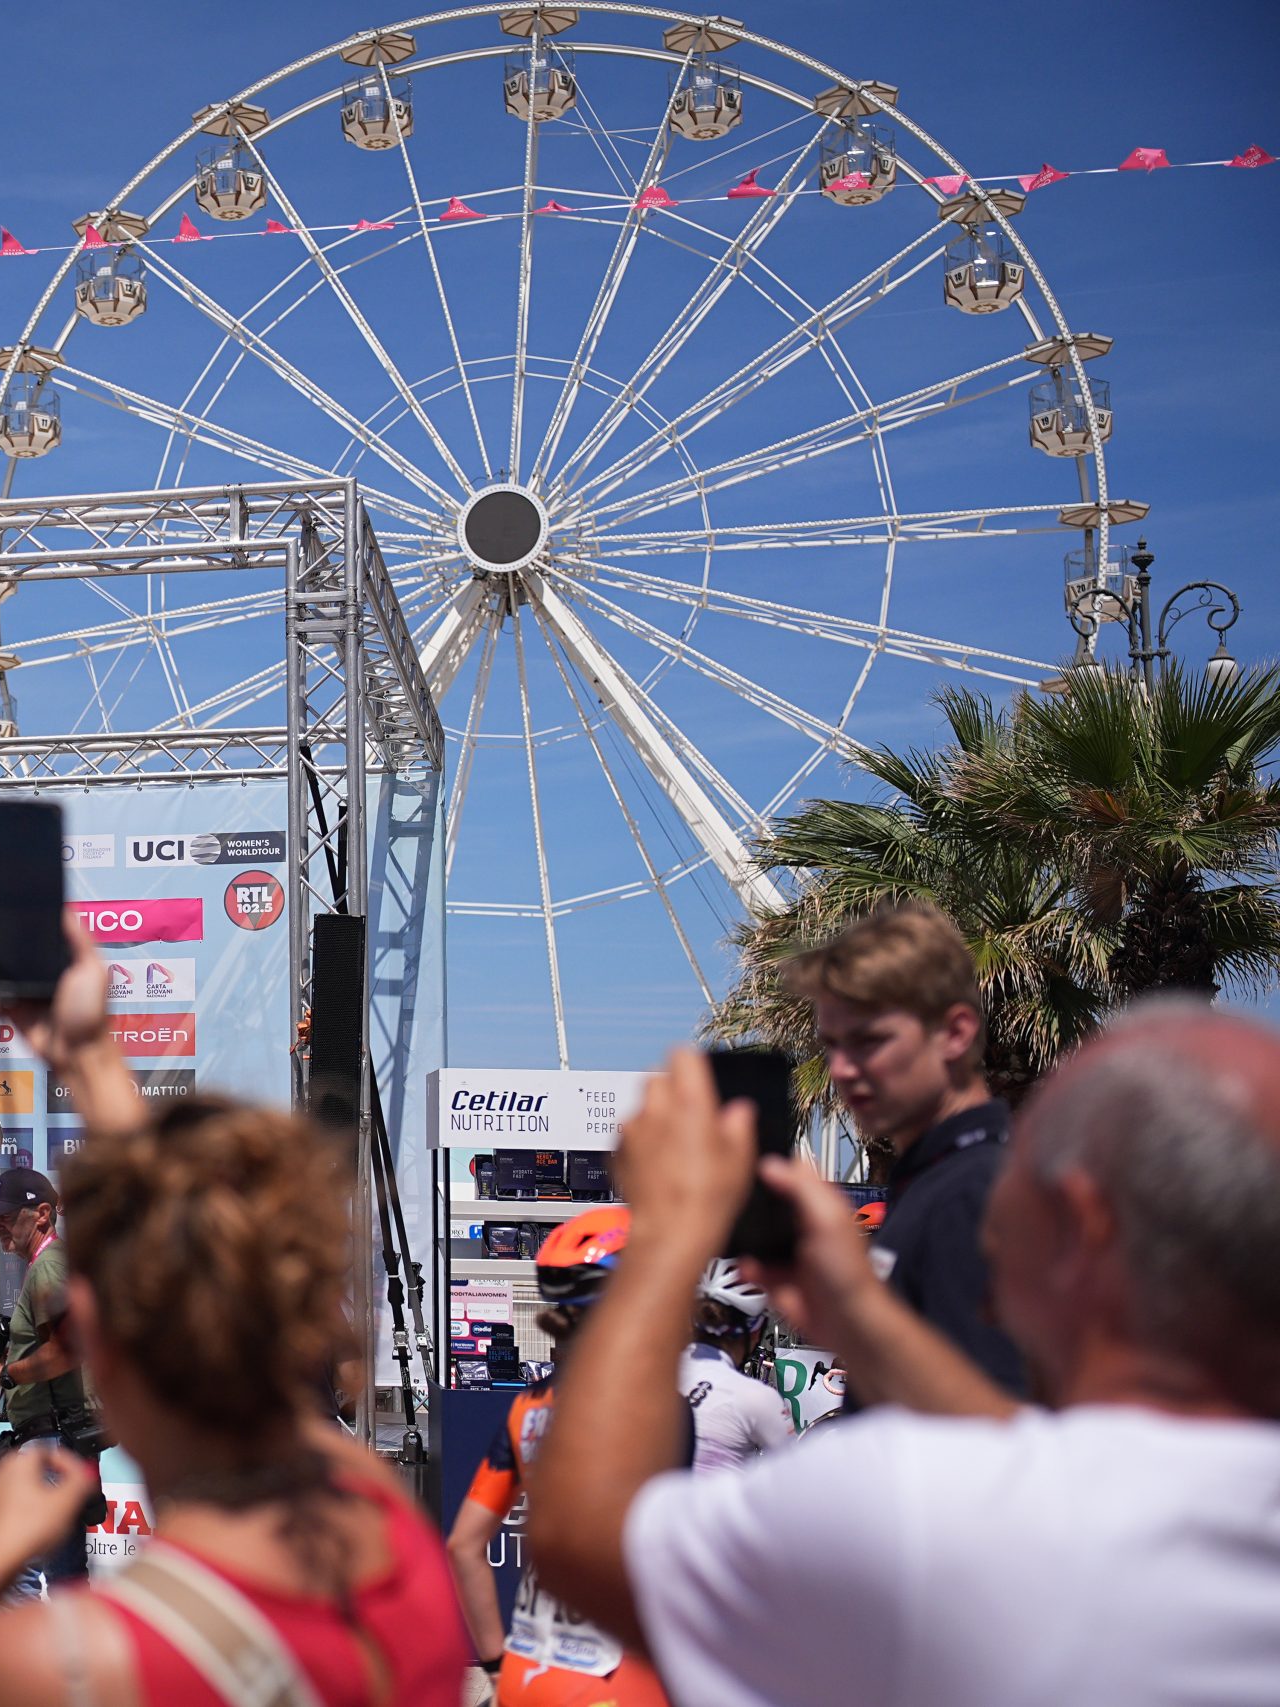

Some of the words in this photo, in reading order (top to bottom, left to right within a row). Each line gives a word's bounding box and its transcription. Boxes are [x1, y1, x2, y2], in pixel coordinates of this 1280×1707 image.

[227, 839, 269, 848] WOMEN'S
[133, 840, 184, 862] UCI
[227, 847, 280, 857] WORLDTOUR
[236, 887, 273, 903] RTL
[236, 902, 273, 914] 102.5
[109, 1028, 188, 1042] TROËN
[141, 1085, 187, 1097] MATTIO
[586, 1091, 615, 1103] FEED
[451, 1090, 548, 1112] Cetilar
[586, 1107, 615, 1118] YOUR
[451, 1114, 549, 1132] NUTRITION
[586, 1122, 623, 1134] PERFO
[124, 1539, 136, 1556] le
